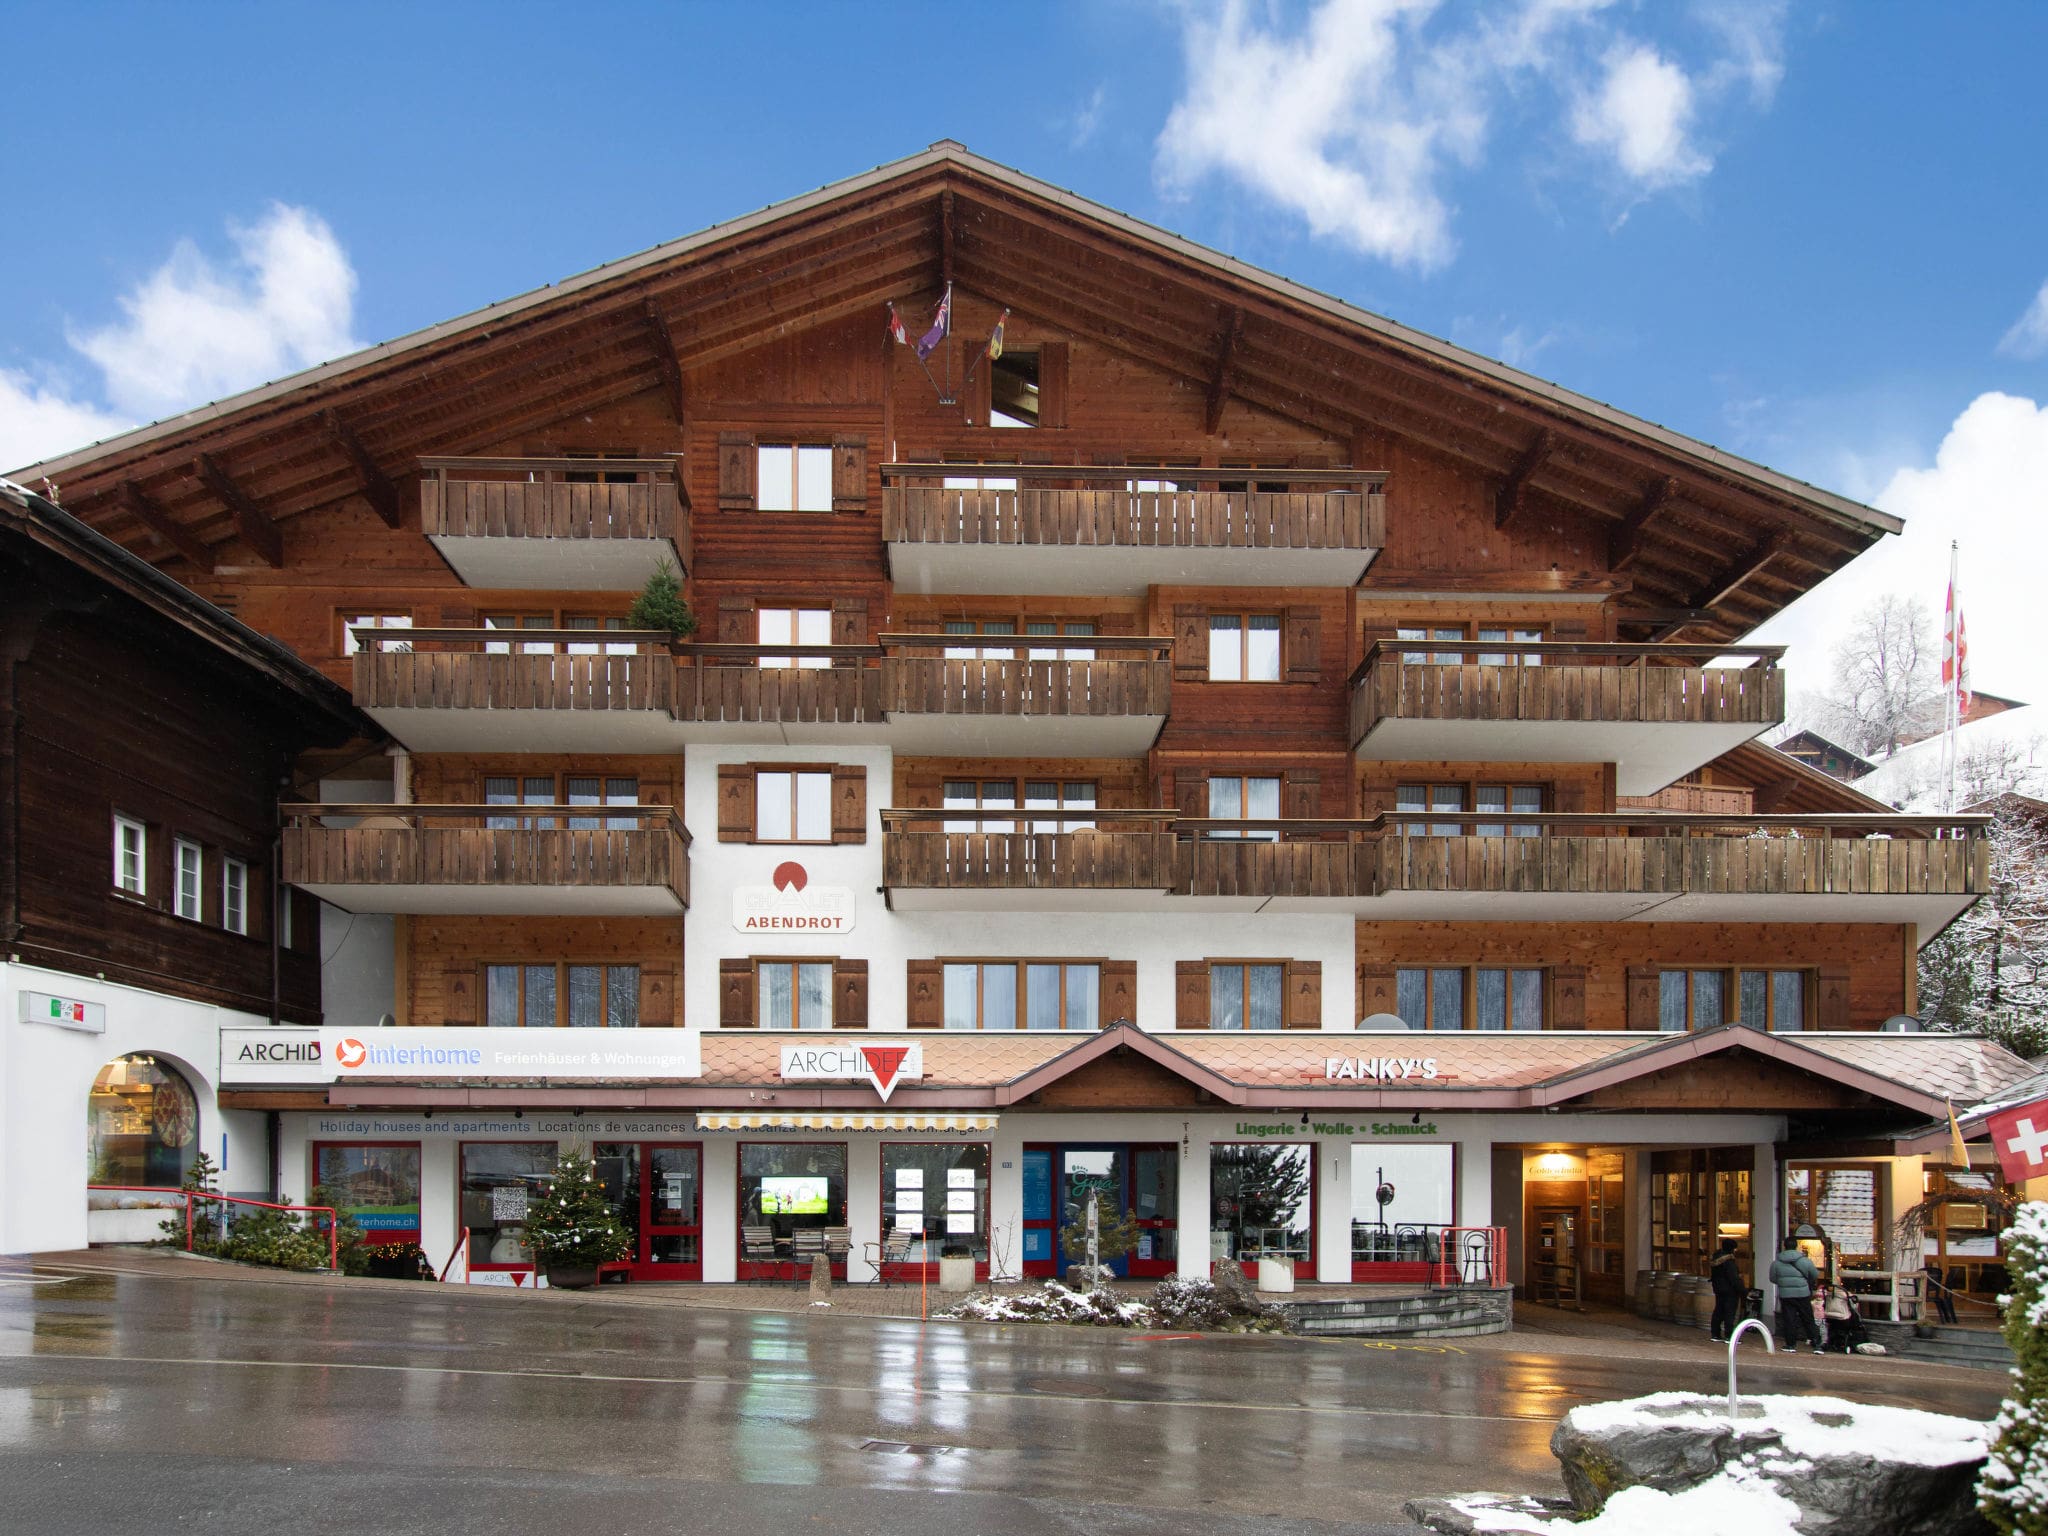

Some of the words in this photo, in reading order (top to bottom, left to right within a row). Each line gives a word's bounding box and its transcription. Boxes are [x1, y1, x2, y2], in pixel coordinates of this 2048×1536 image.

[746, 917, 843, 928] ABENDROT
[370, 1044, 481, 1064] interhome
[495, 1051, 586, 1065] Ferienhäuser
[590, 1053, 600, 1064] &
[605, 1052, 686, 1067] Wohnungen
[788, 1051, 908, 1073] ARCHIDEE
[1325, 1057, 1438, 1079] FANKY'S
[320, 1121, 370, 1134] Holiday
[374, 1121, 421, 1133] houses
[425, 1121, 449, 1133] and
[453, 1121, 530, 1134] apartments
[538, 1121, 601, 1133] Locations
[605, 1121, 621, 1133] de
[625, 1123, 686, 1133] vacances
[1236, 1123, 1295, 1137] Lingerie
[1312, 1123, 1354, 1135] Wolle
[1371, 1123, 1438, 1135] Schmuck
